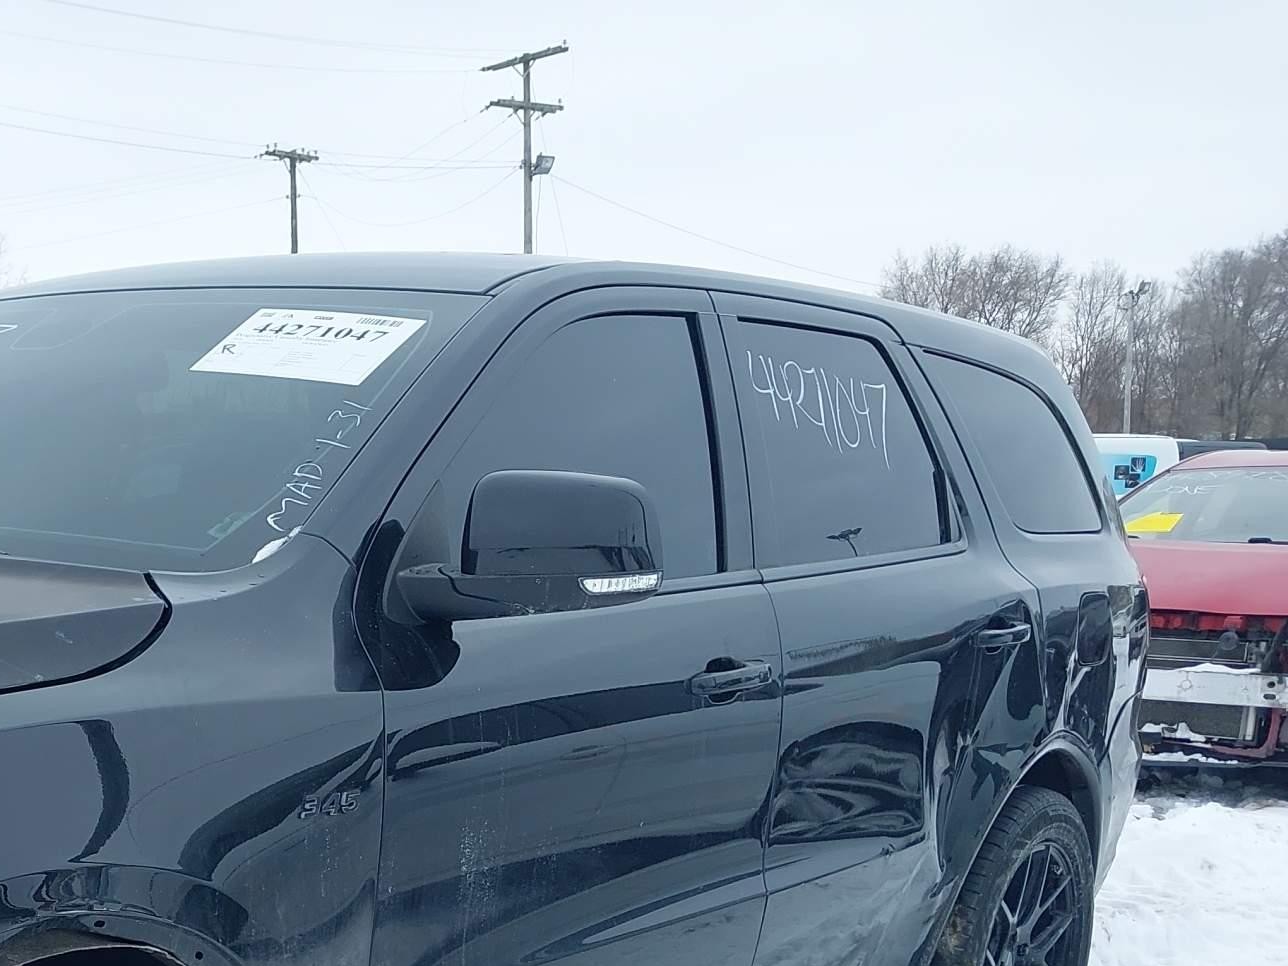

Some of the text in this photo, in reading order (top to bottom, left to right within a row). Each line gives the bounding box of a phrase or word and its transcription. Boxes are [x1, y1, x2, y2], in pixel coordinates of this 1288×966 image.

[253, 322, 389, 343] 44271047
[315, 399, 373, 449] 1-31
[746, 350, 891, 470] 44271047
